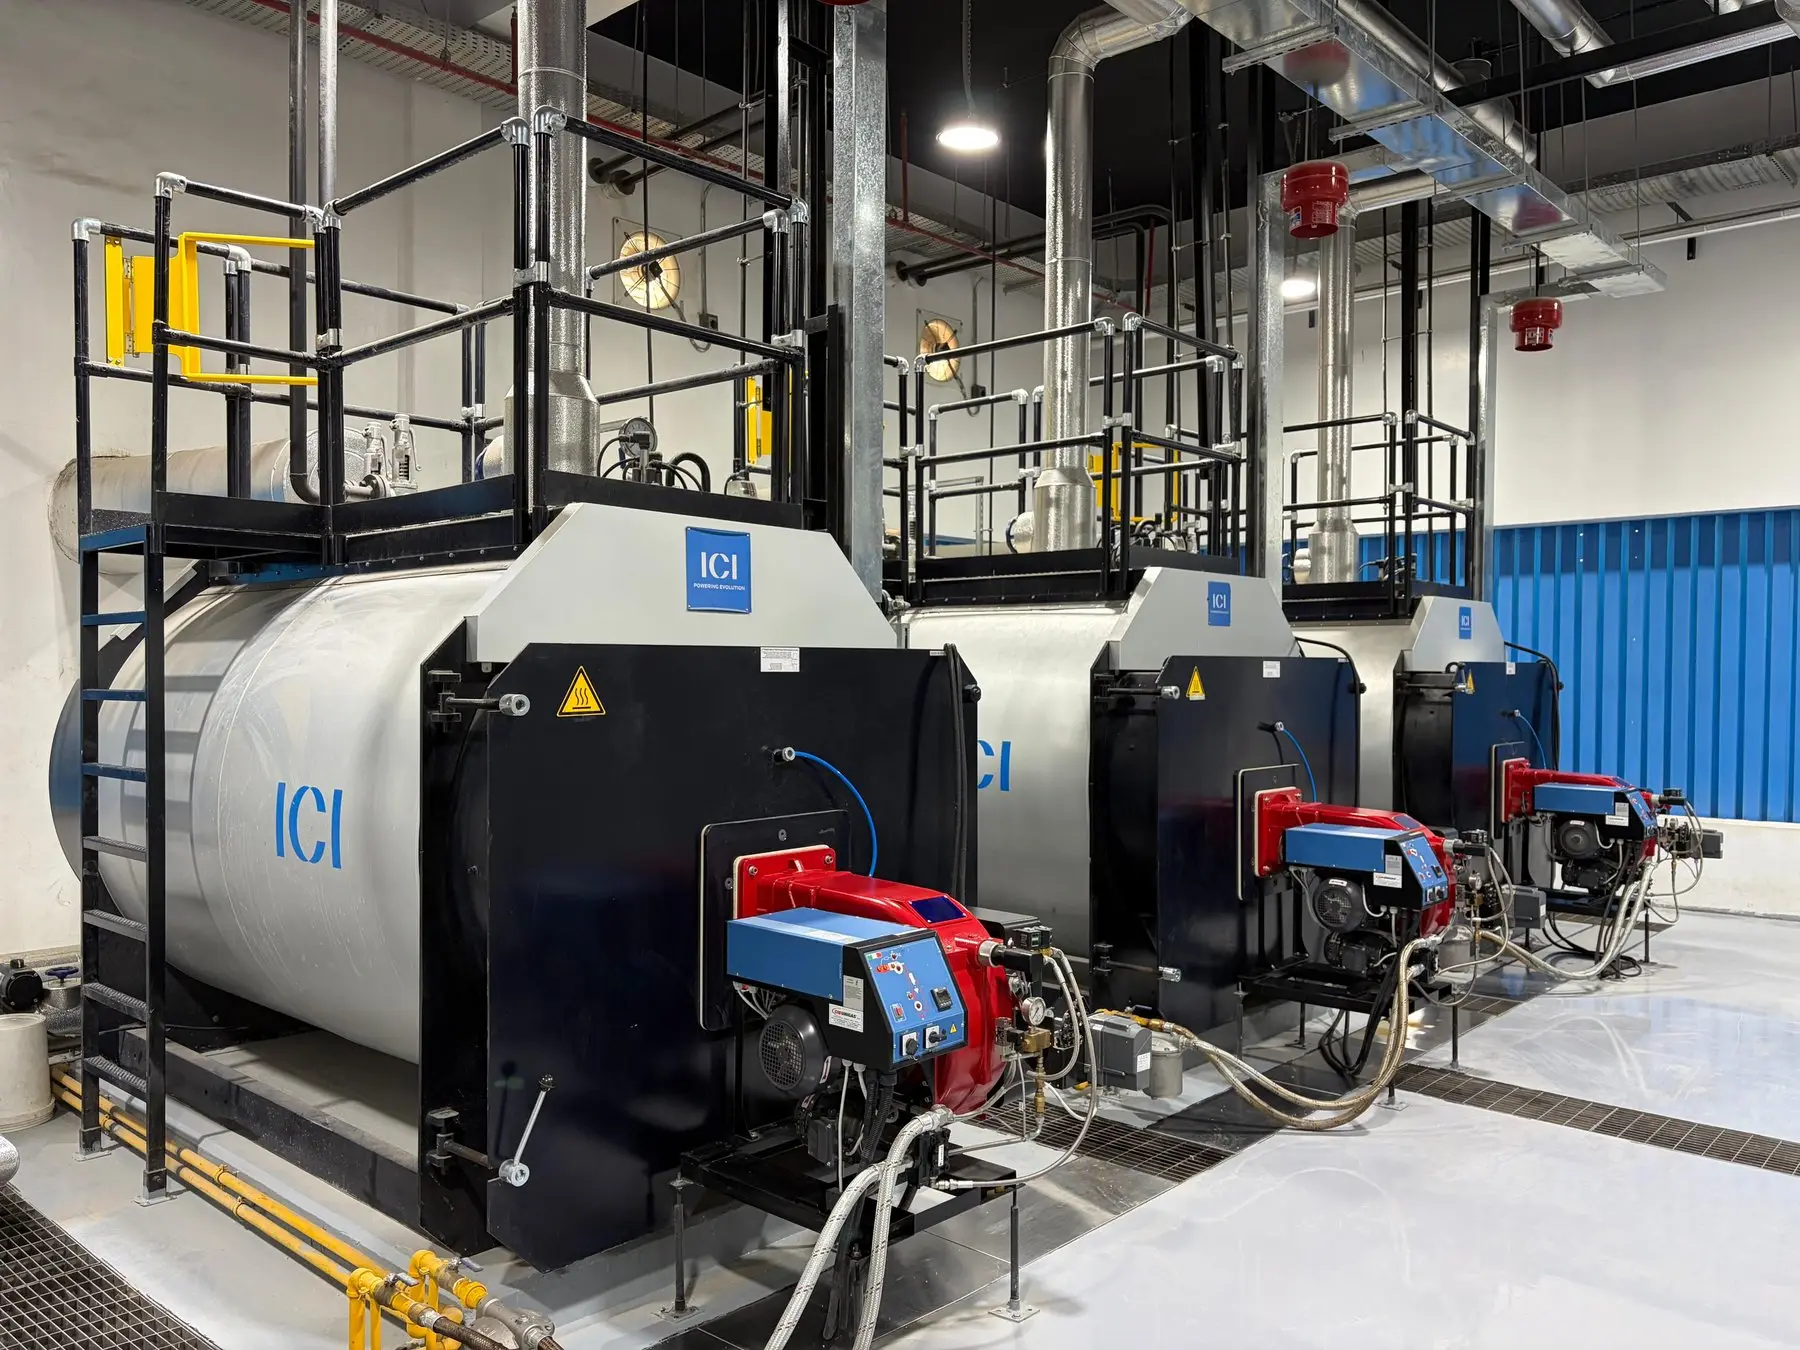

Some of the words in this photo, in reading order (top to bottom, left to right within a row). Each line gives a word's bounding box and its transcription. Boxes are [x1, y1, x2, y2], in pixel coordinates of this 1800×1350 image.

[701, 551, 738, 580] ICI
[693, 582, 719, 590] POWERING
[719, 584, 746, 592] EVOLUTION
[1212, 593, 1227, 609] ICI
[977, 739, 1011, 792] CI
[275, 782, 343, 869] ICI
